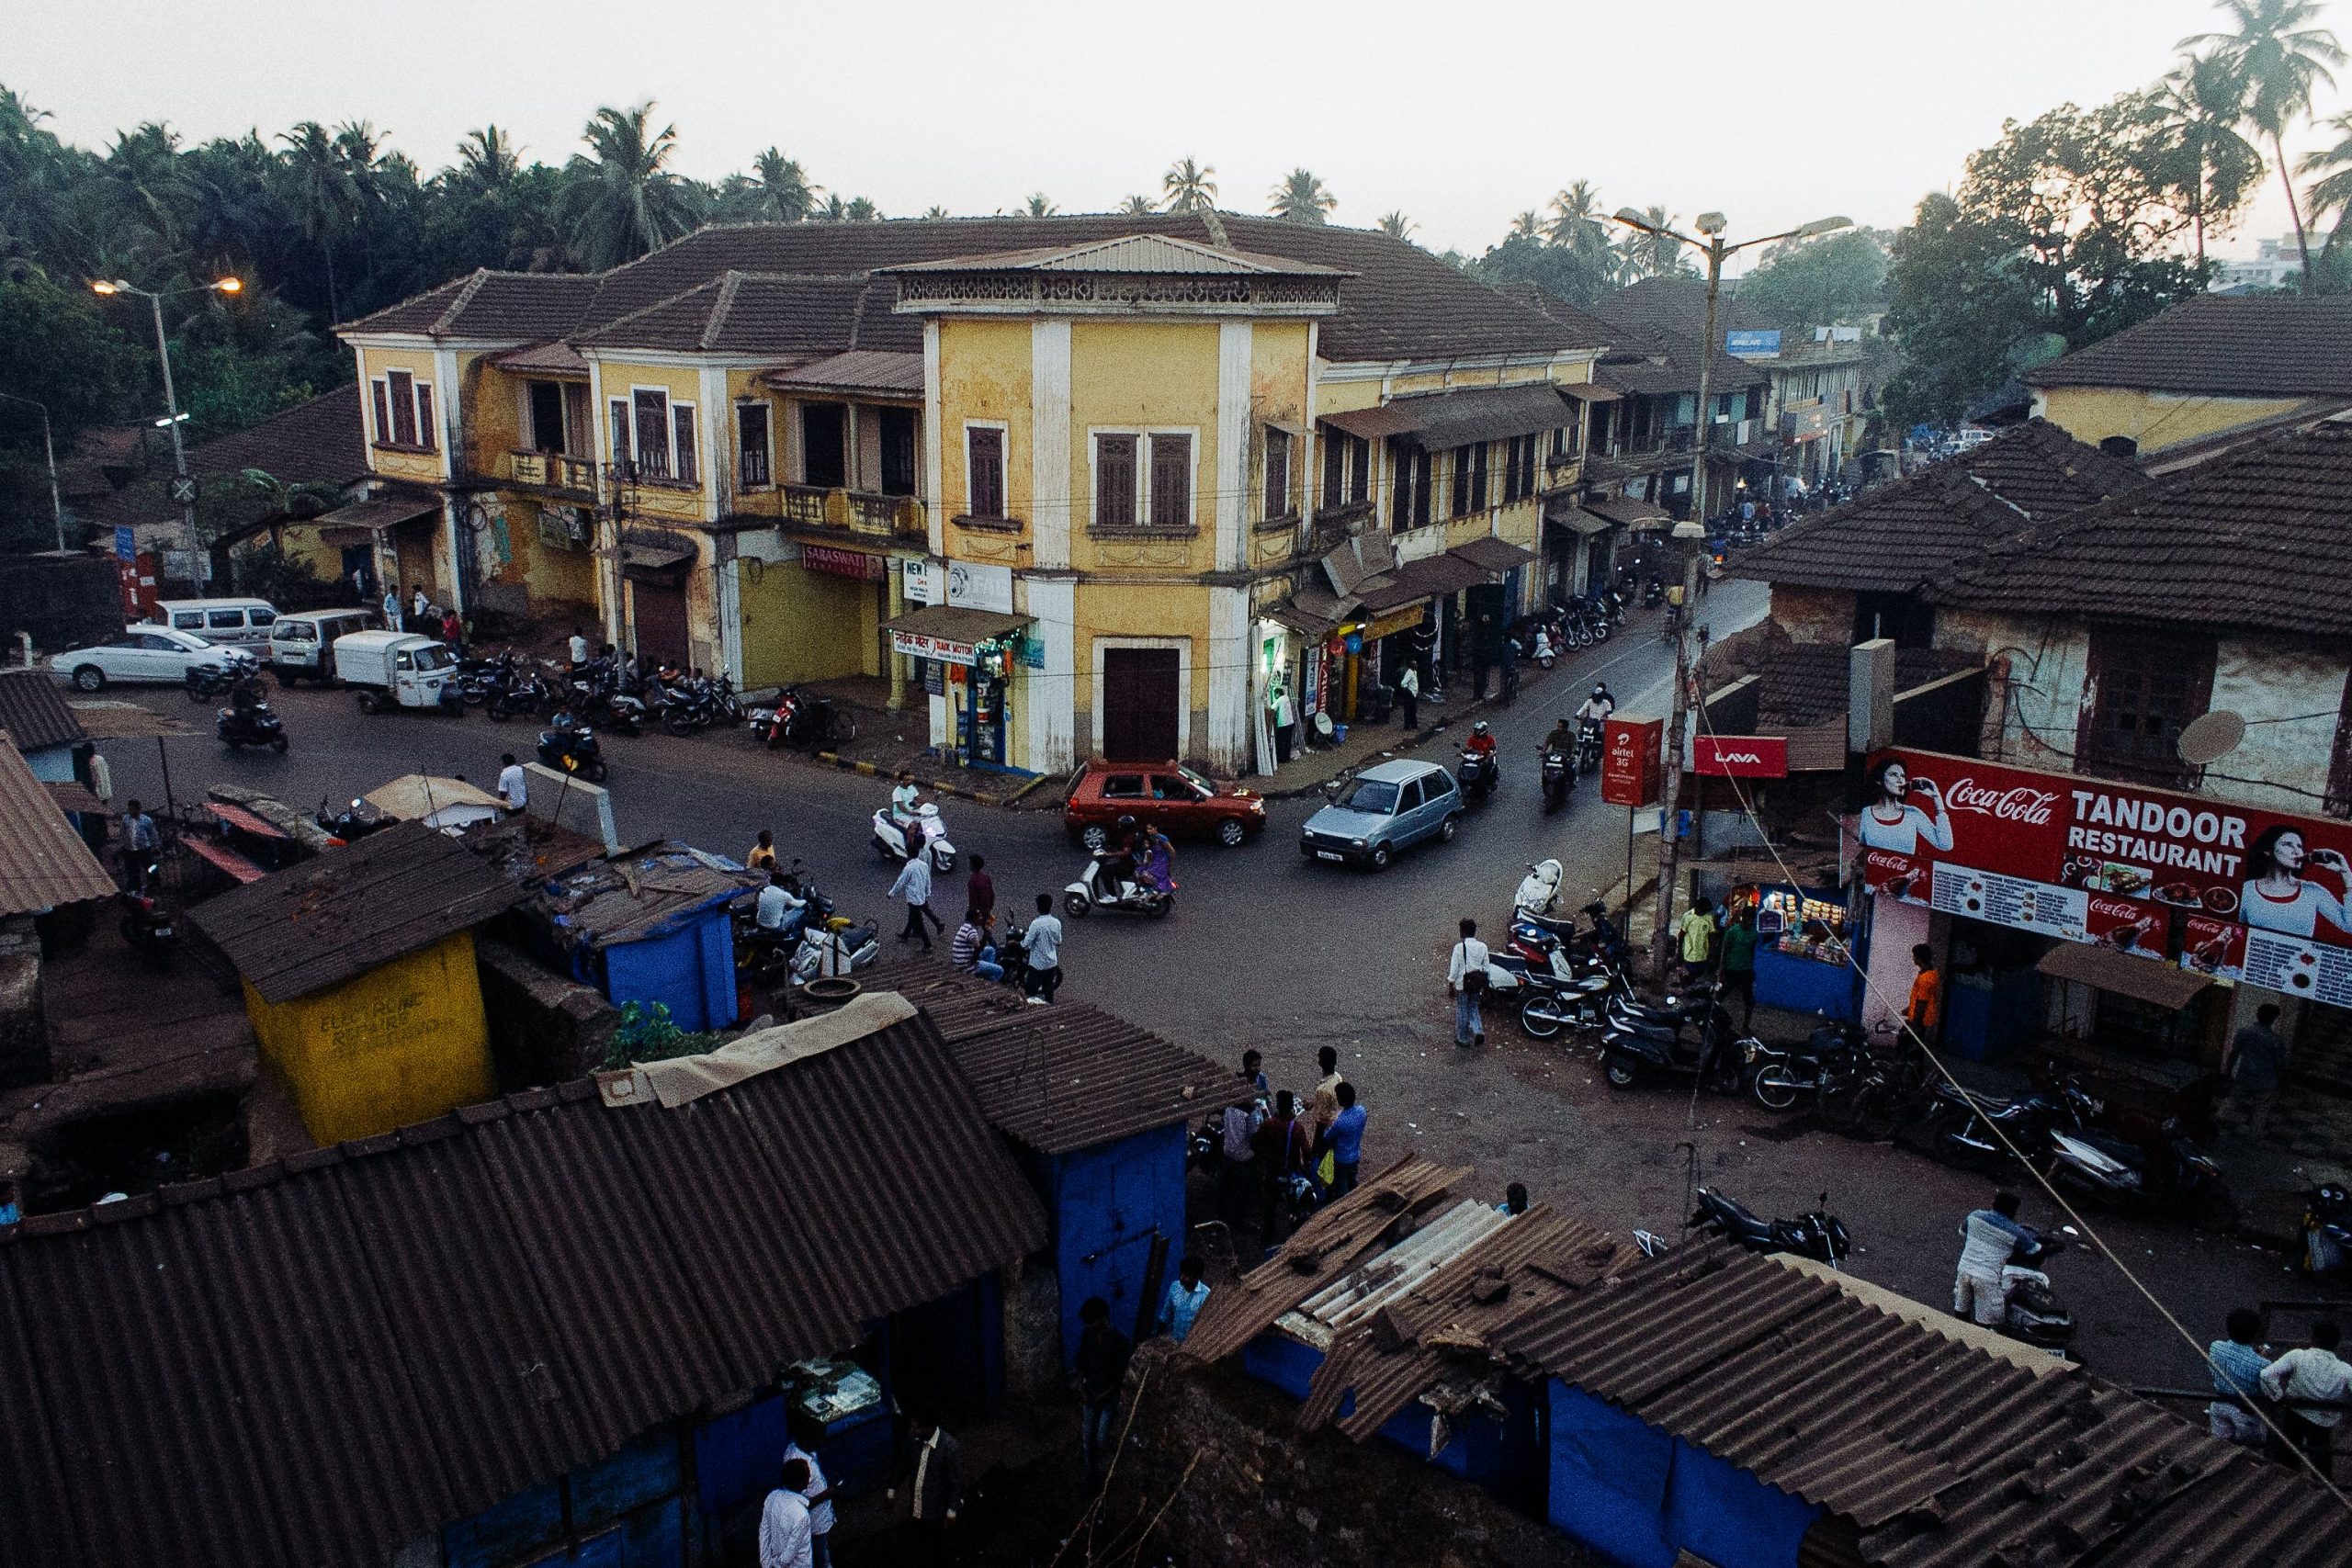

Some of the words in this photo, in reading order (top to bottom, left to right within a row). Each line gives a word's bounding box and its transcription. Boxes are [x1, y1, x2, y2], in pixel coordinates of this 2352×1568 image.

[806, 546, 865, 568] SARASWATI
[906, 562, 922, 575] NEW
[1611, 747, 1634, 758] airtel
[1714, 752, 1761, 763] LAVA
[1616, 758, 1629, 767] 3G
[2071, 790, 2247, 850] TANDOOR
[2067, 827, 2242, 877] RESTAURANT
